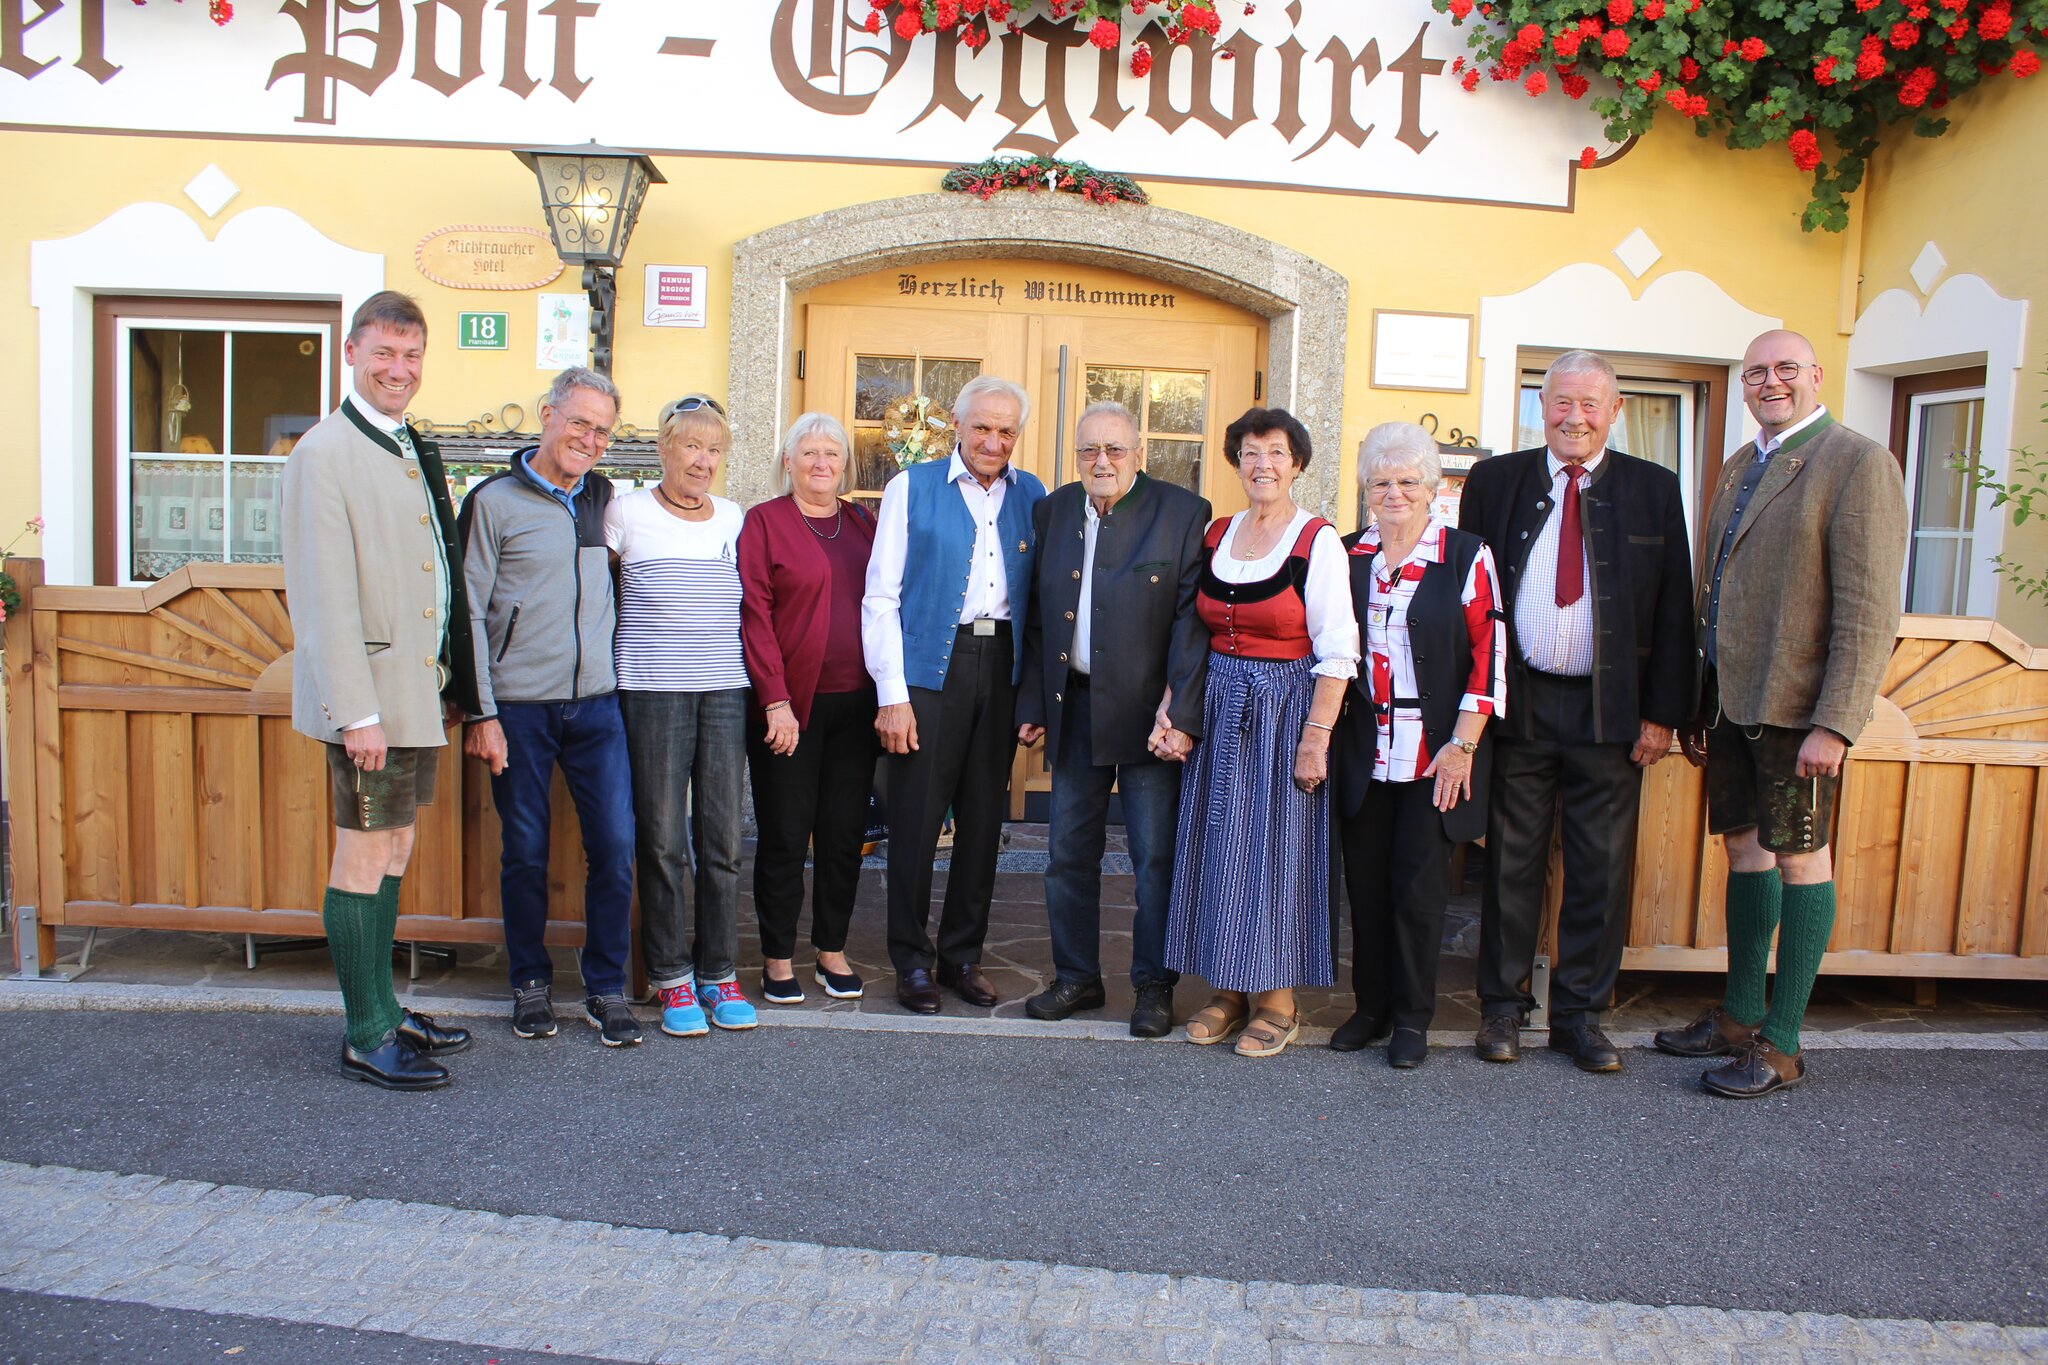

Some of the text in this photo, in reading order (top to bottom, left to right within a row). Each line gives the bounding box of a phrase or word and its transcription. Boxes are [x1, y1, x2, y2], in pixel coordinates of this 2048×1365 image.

[447, 239, 536, 256] Nichtraucher
[473, 259, 505, 275] Hotel
[660, 276, 691, 284] GENUSS
[660, 285, 691, 293] REGION
[898, 273, 1176, 309] Herzlich Willkommen
[470, 316, 496, 339] 18
